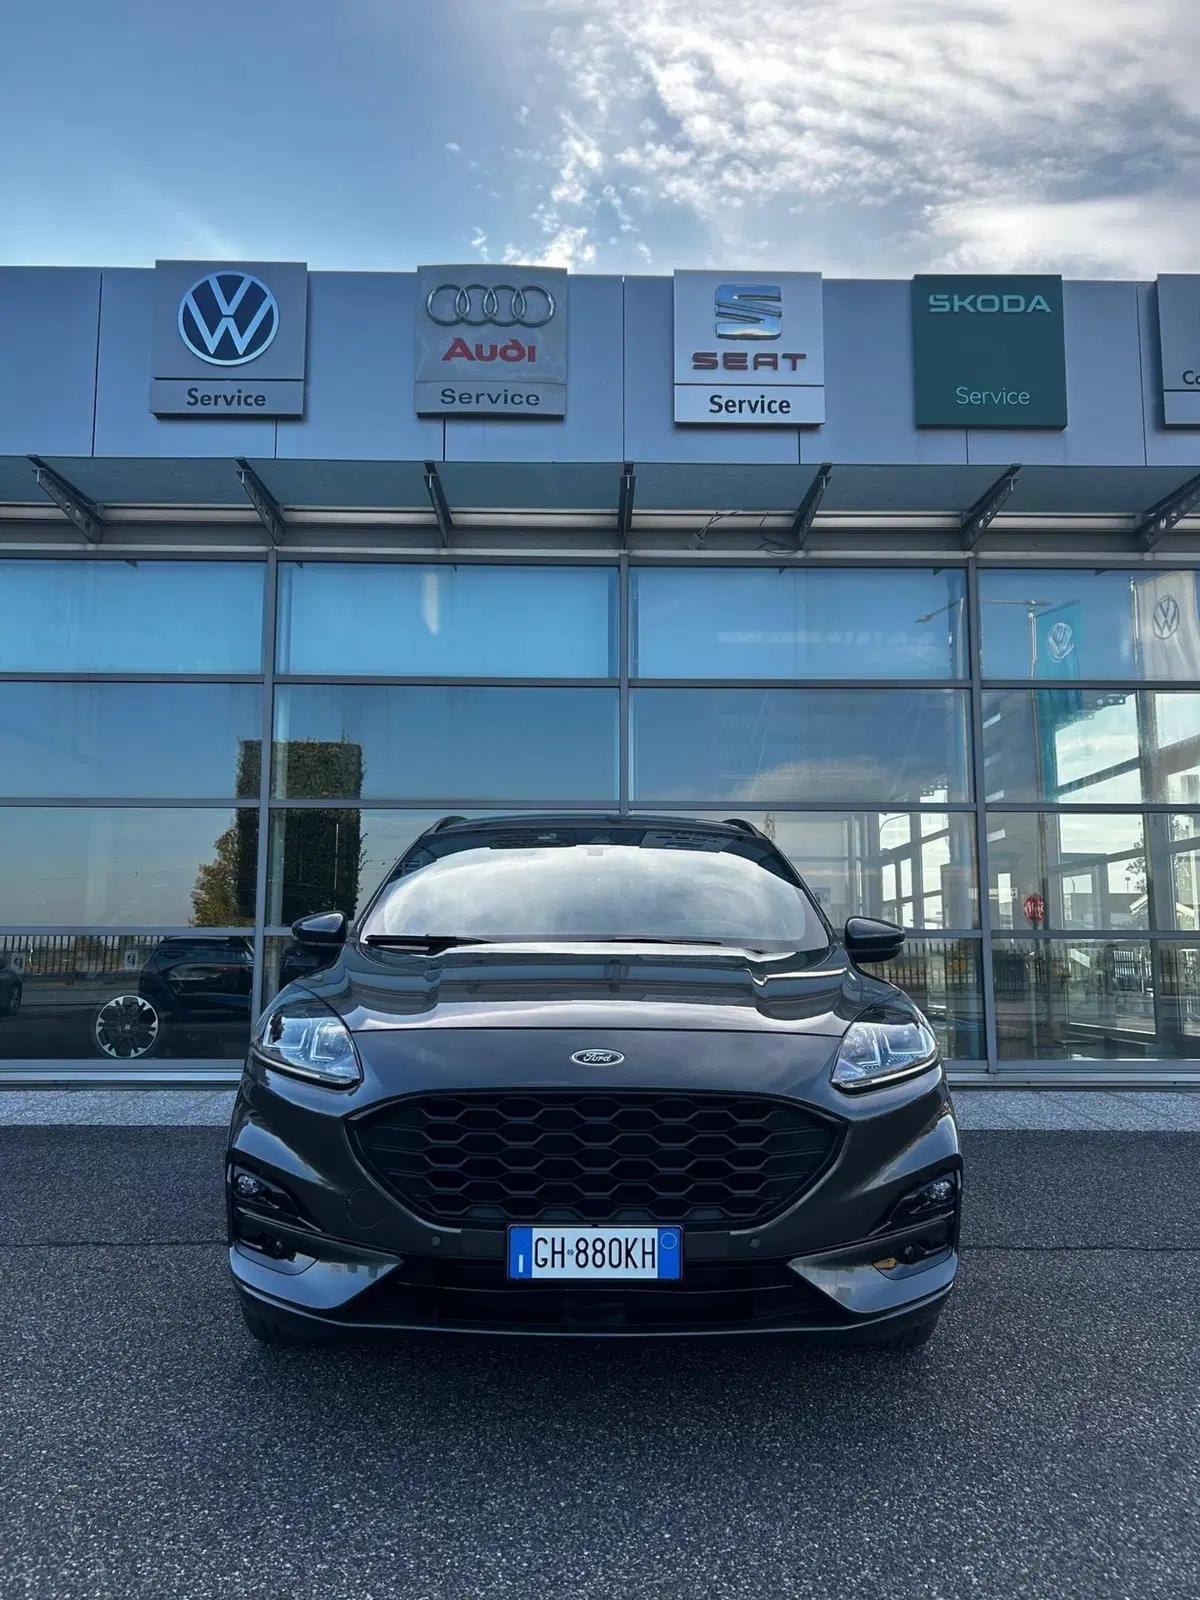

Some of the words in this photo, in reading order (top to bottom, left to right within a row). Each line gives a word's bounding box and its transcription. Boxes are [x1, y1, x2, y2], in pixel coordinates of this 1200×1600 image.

[442, 338, 536, 363] Audi
[692, 352, 807, 370] SEAT
[186, 388, 267, 407] Service
[440, 388, 540, 406] Service
[709, 395, 792, 415] Service
[955, 386, 1031, 405] Service
[583, 1052, 612, 1062] Ford
